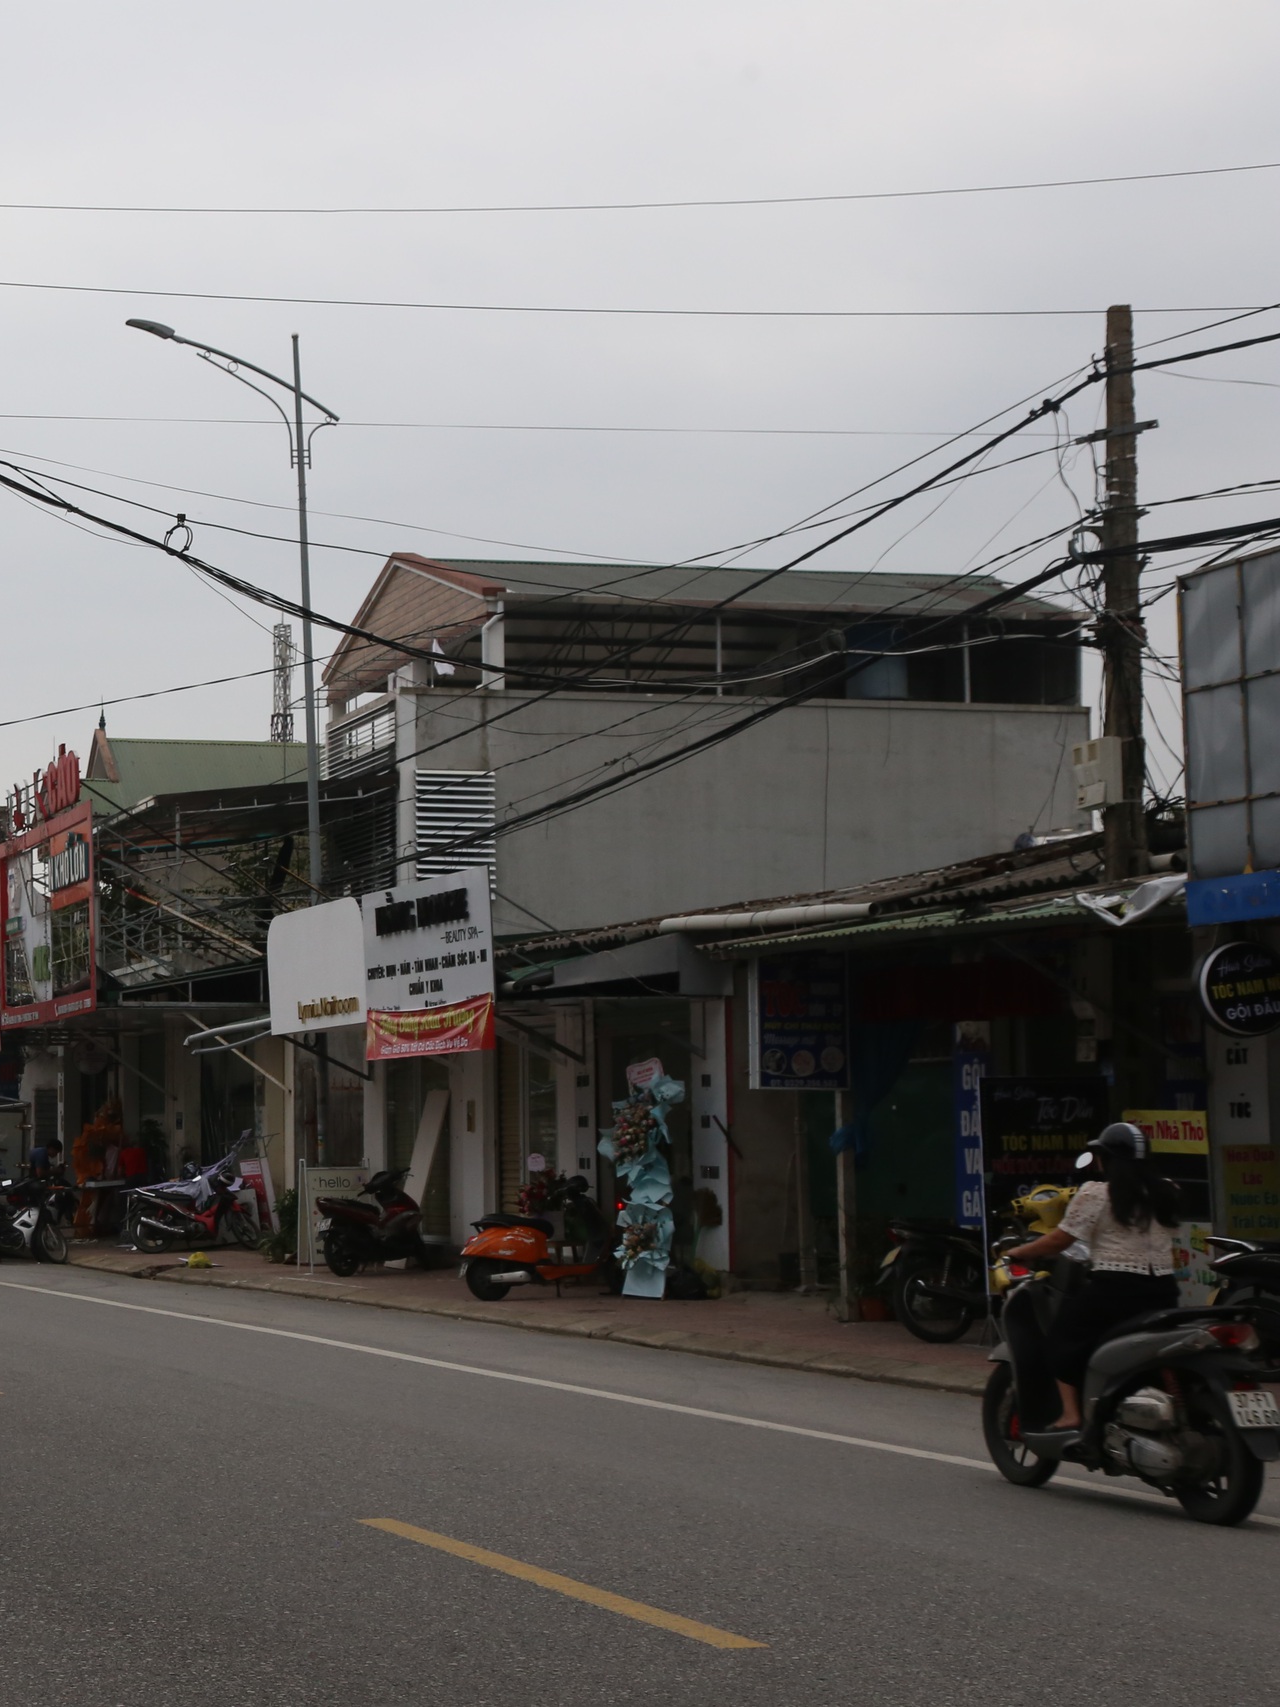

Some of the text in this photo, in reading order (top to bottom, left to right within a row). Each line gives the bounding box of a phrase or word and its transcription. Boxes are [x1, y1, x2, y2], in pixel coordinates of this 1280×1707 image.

[445, 926, 478, 944] BEAUTY SPA
[457, 950, 467, 967] SÓC
[1236, 978, 1266, 998] NAM
[1225, 1002, 1252, 1022] GỘI
[1032, 1134, 1065, 1151] NAM
[319, 1176, 351, 1189] hello
